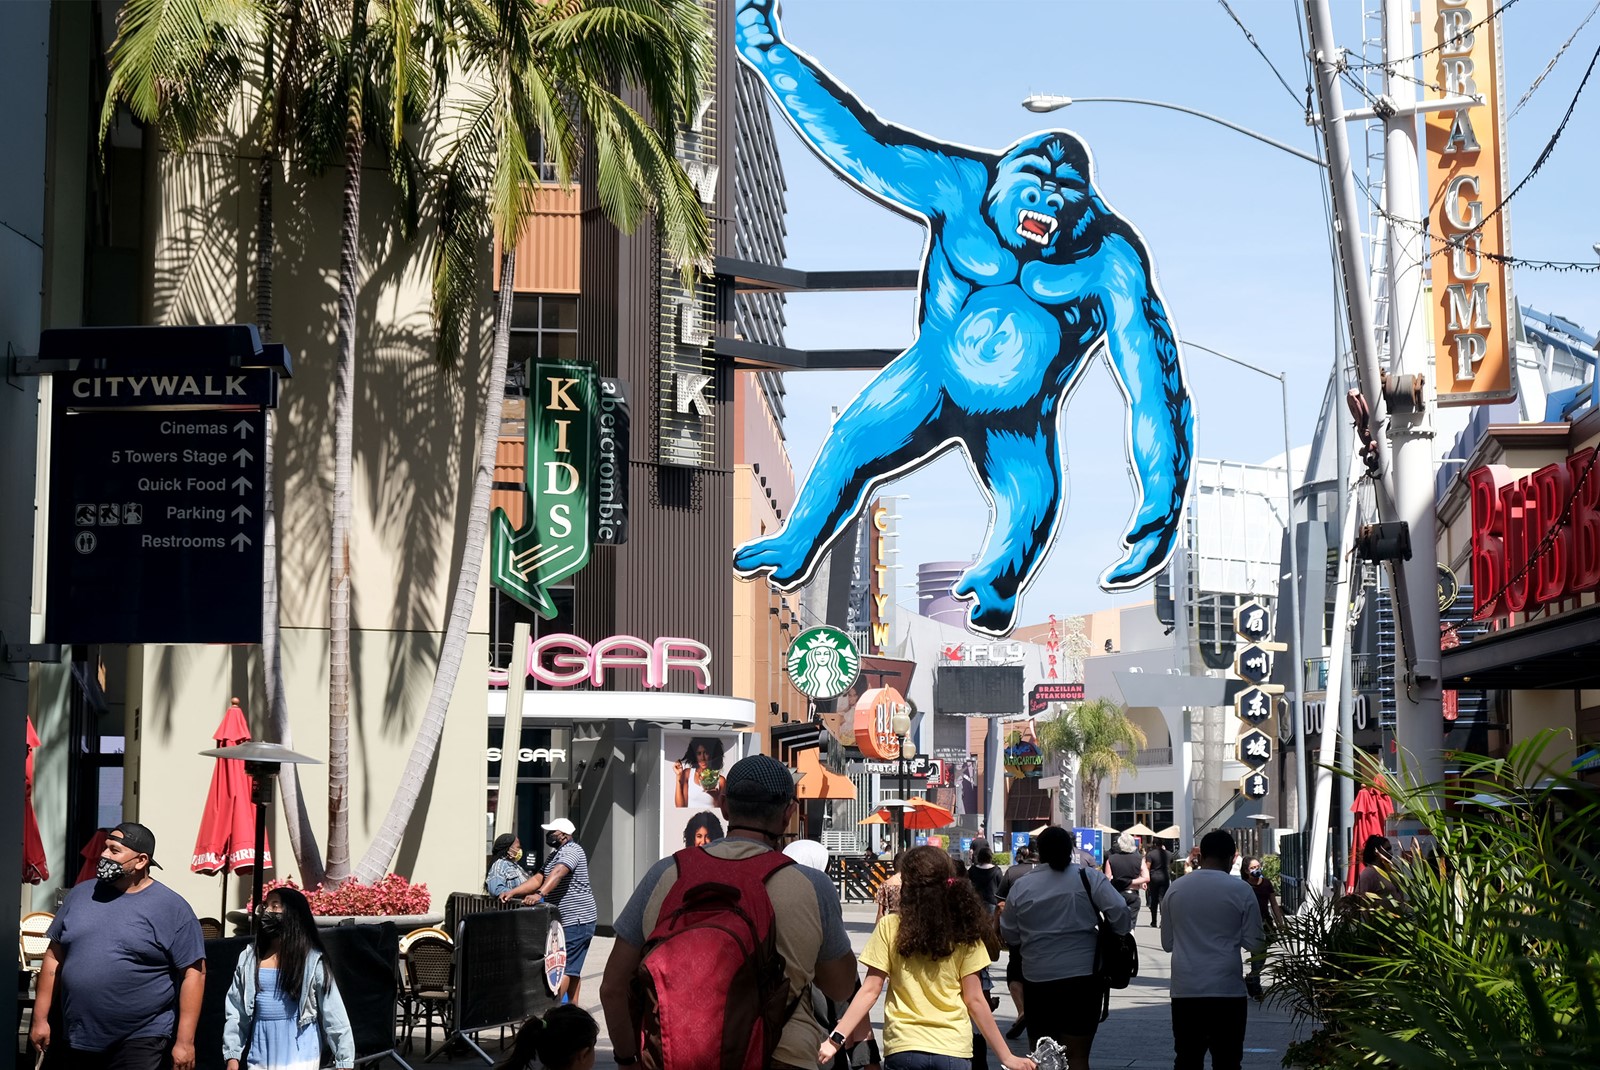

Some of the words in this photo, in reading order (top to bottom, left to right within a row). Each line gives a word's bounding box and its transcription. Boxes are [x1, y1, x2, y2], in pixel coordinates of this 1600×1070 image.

[1443, 175, 1492, 381] GUMP
[72, 375, 248, 398] CITYWALK
[160, 421, 228, 434] Cinemas
[111, 451, 120, 463] 5
[125, 450, 178, 463] Towers
[182, 450, 227, 465] Stage
[543, 376, 580, 538] KIDS
[598, 381, 625, 540] abercrombie
[138, 478, 182, 491] Quick
[187, 478, 226, 491] Food
[167, 506, 226, 522] Parking
[141, 535, 226, 548] Restrooms
[1046, 614, 1060, 680] SAMBA
[487, 747, 566, 763] SGAR
